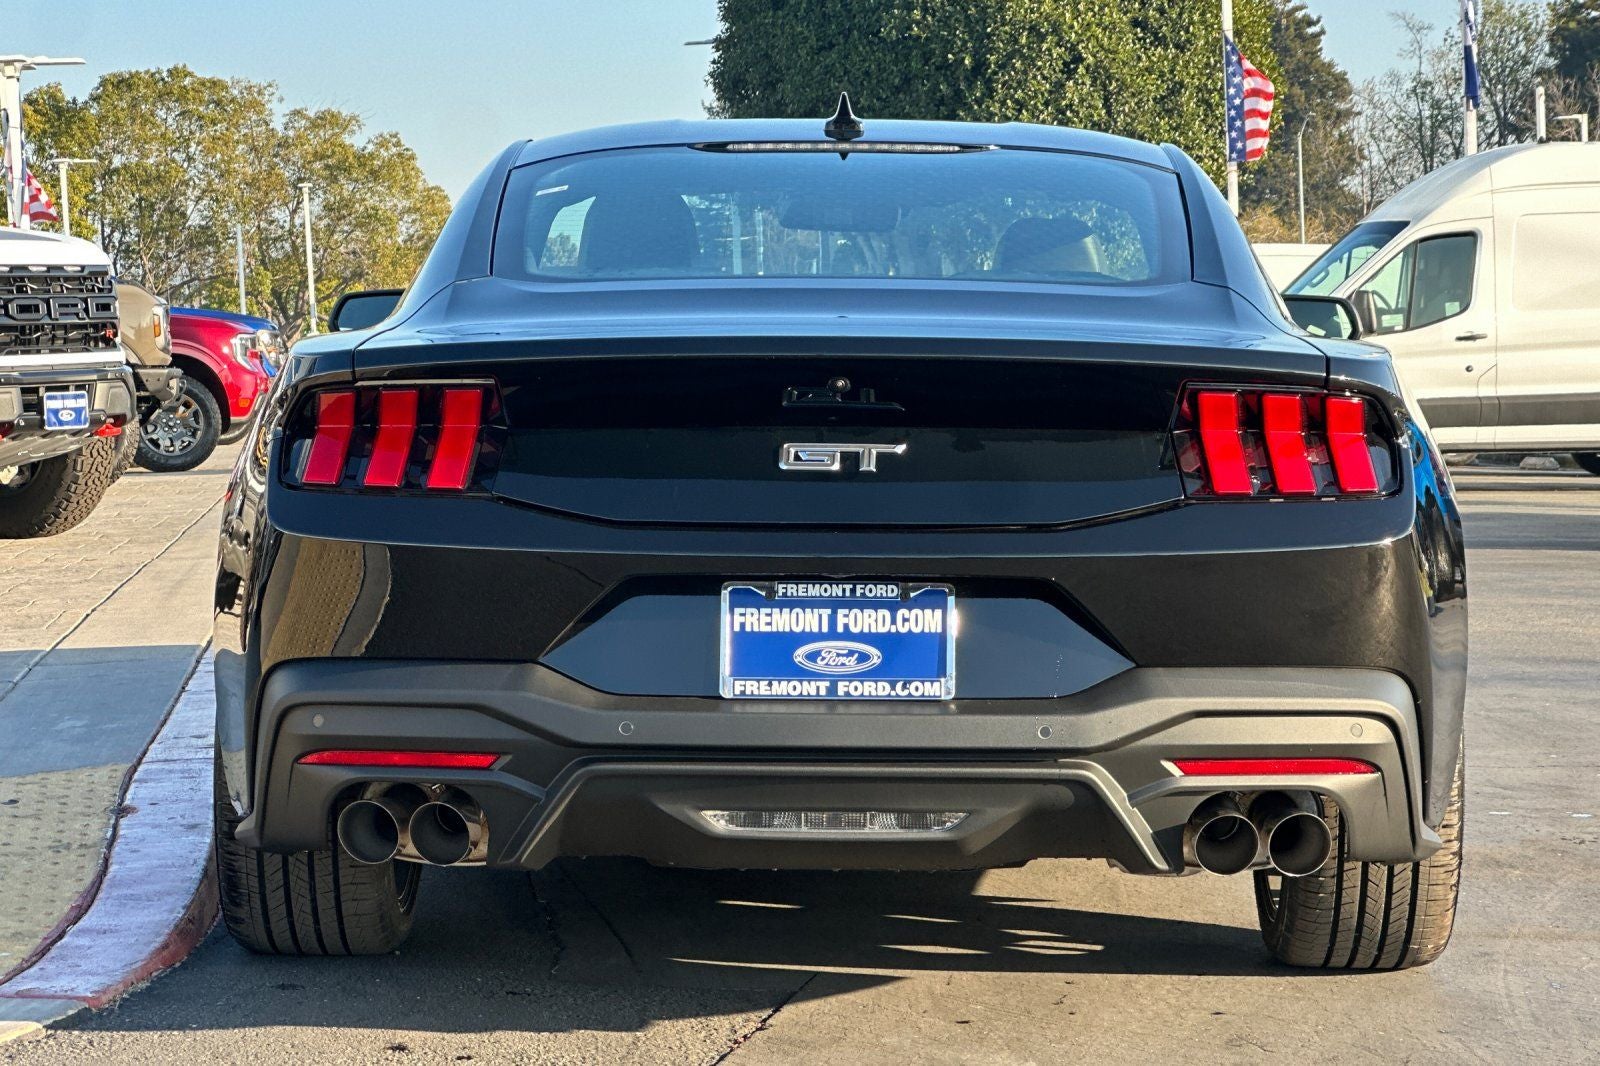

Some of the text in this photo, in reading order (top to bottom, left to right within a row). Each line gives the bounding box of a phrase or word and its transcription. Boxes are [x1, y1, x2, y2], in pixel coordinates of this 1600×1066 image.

[0, 296, 118, 320] ORD
[779, 443, 907, 472] GT
[777, 583, 899, 598] FREMONT FORD
[733, 607, 943, 634] FREMONT FORD.COM
[816, 649, 858, 666] Ford
[734, 680, 941, 697] FREMONT FORD.COM
